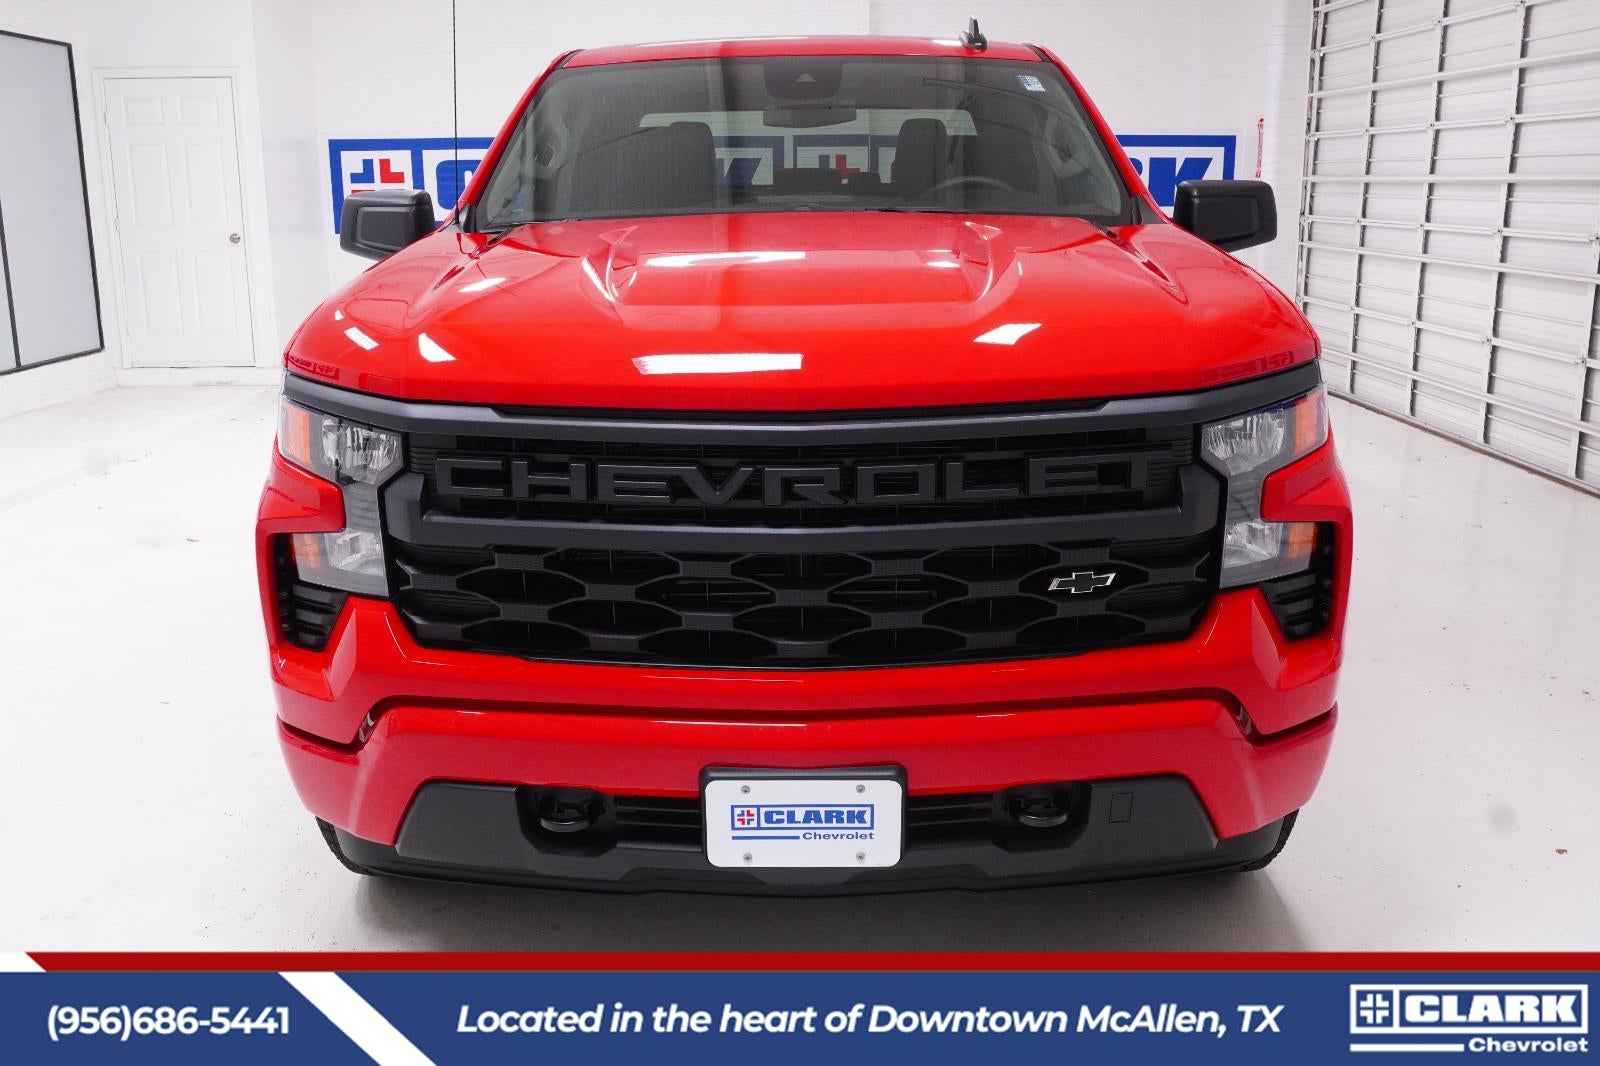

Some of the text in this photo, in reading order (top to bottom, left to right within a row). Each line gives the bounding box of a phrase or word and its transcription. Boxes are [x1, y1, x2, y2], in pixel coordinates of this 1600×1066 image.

[436, 451, 1149, 505] CHEVROLET
[763, 809, 868, 825] CLARK
[802, 831, 875, 841] Chevrolet
